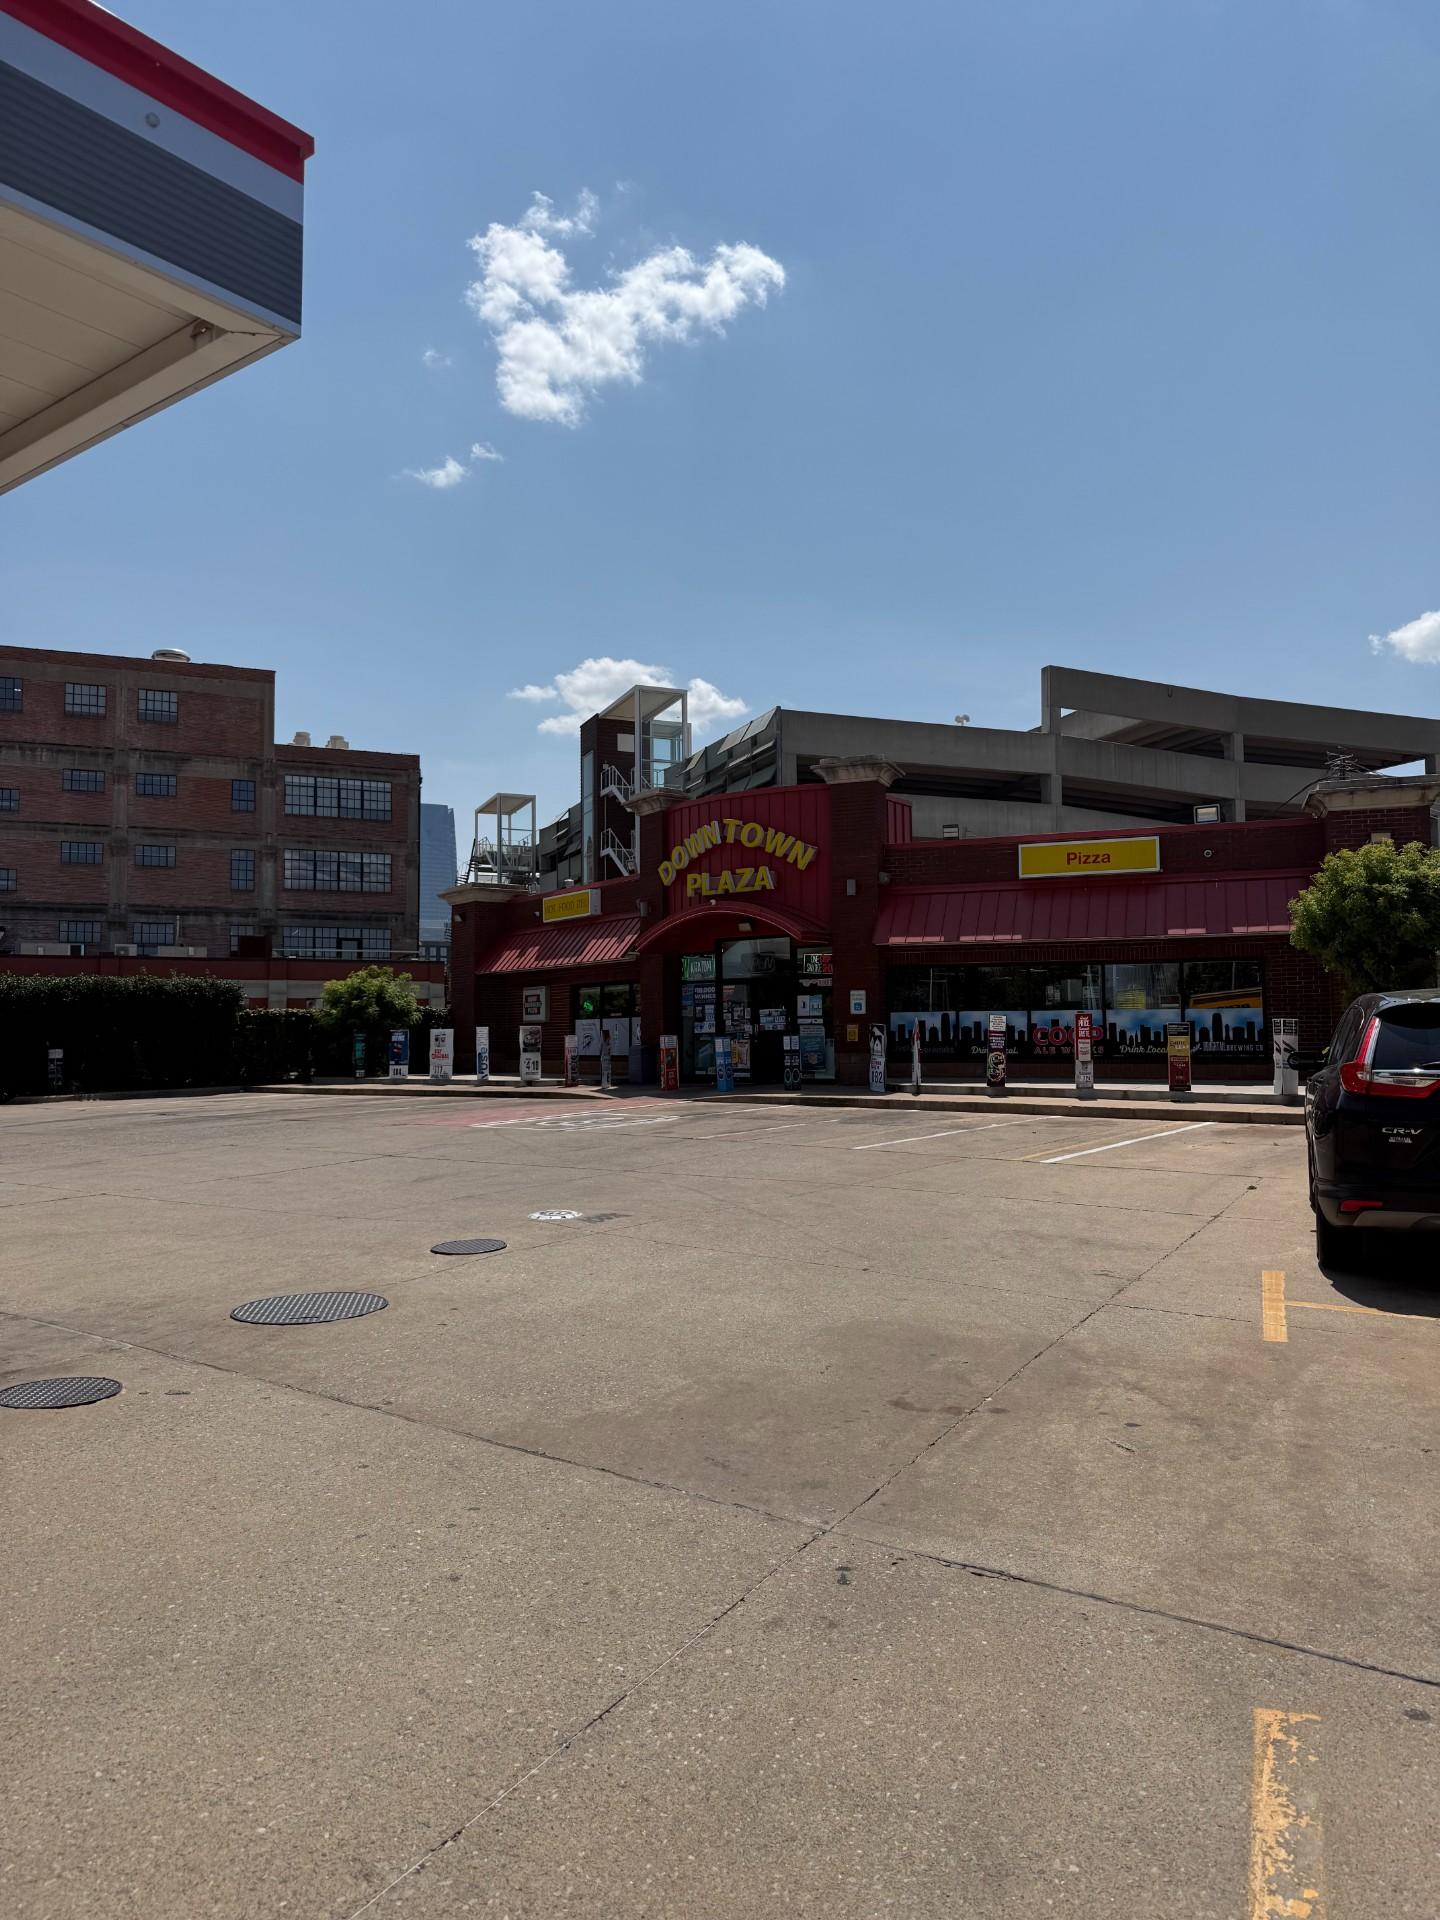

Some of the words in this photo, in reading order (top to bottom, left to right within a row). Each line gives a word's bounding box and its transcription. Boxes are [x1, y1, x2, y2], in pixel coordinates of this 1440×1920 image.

[657, 818, 818, 887] DOWNTOWN
[1066, 851, 1111, 865] Pizza
[686, 866, 775, 897] PLAZA
[970, 1045, 988, 1055] Drin
[1119, 1044, 1145, 1054] Drink
[1145, 1044, 1168, 1054] Loca
[1381, 1126, 1424, 1134] CR-V
